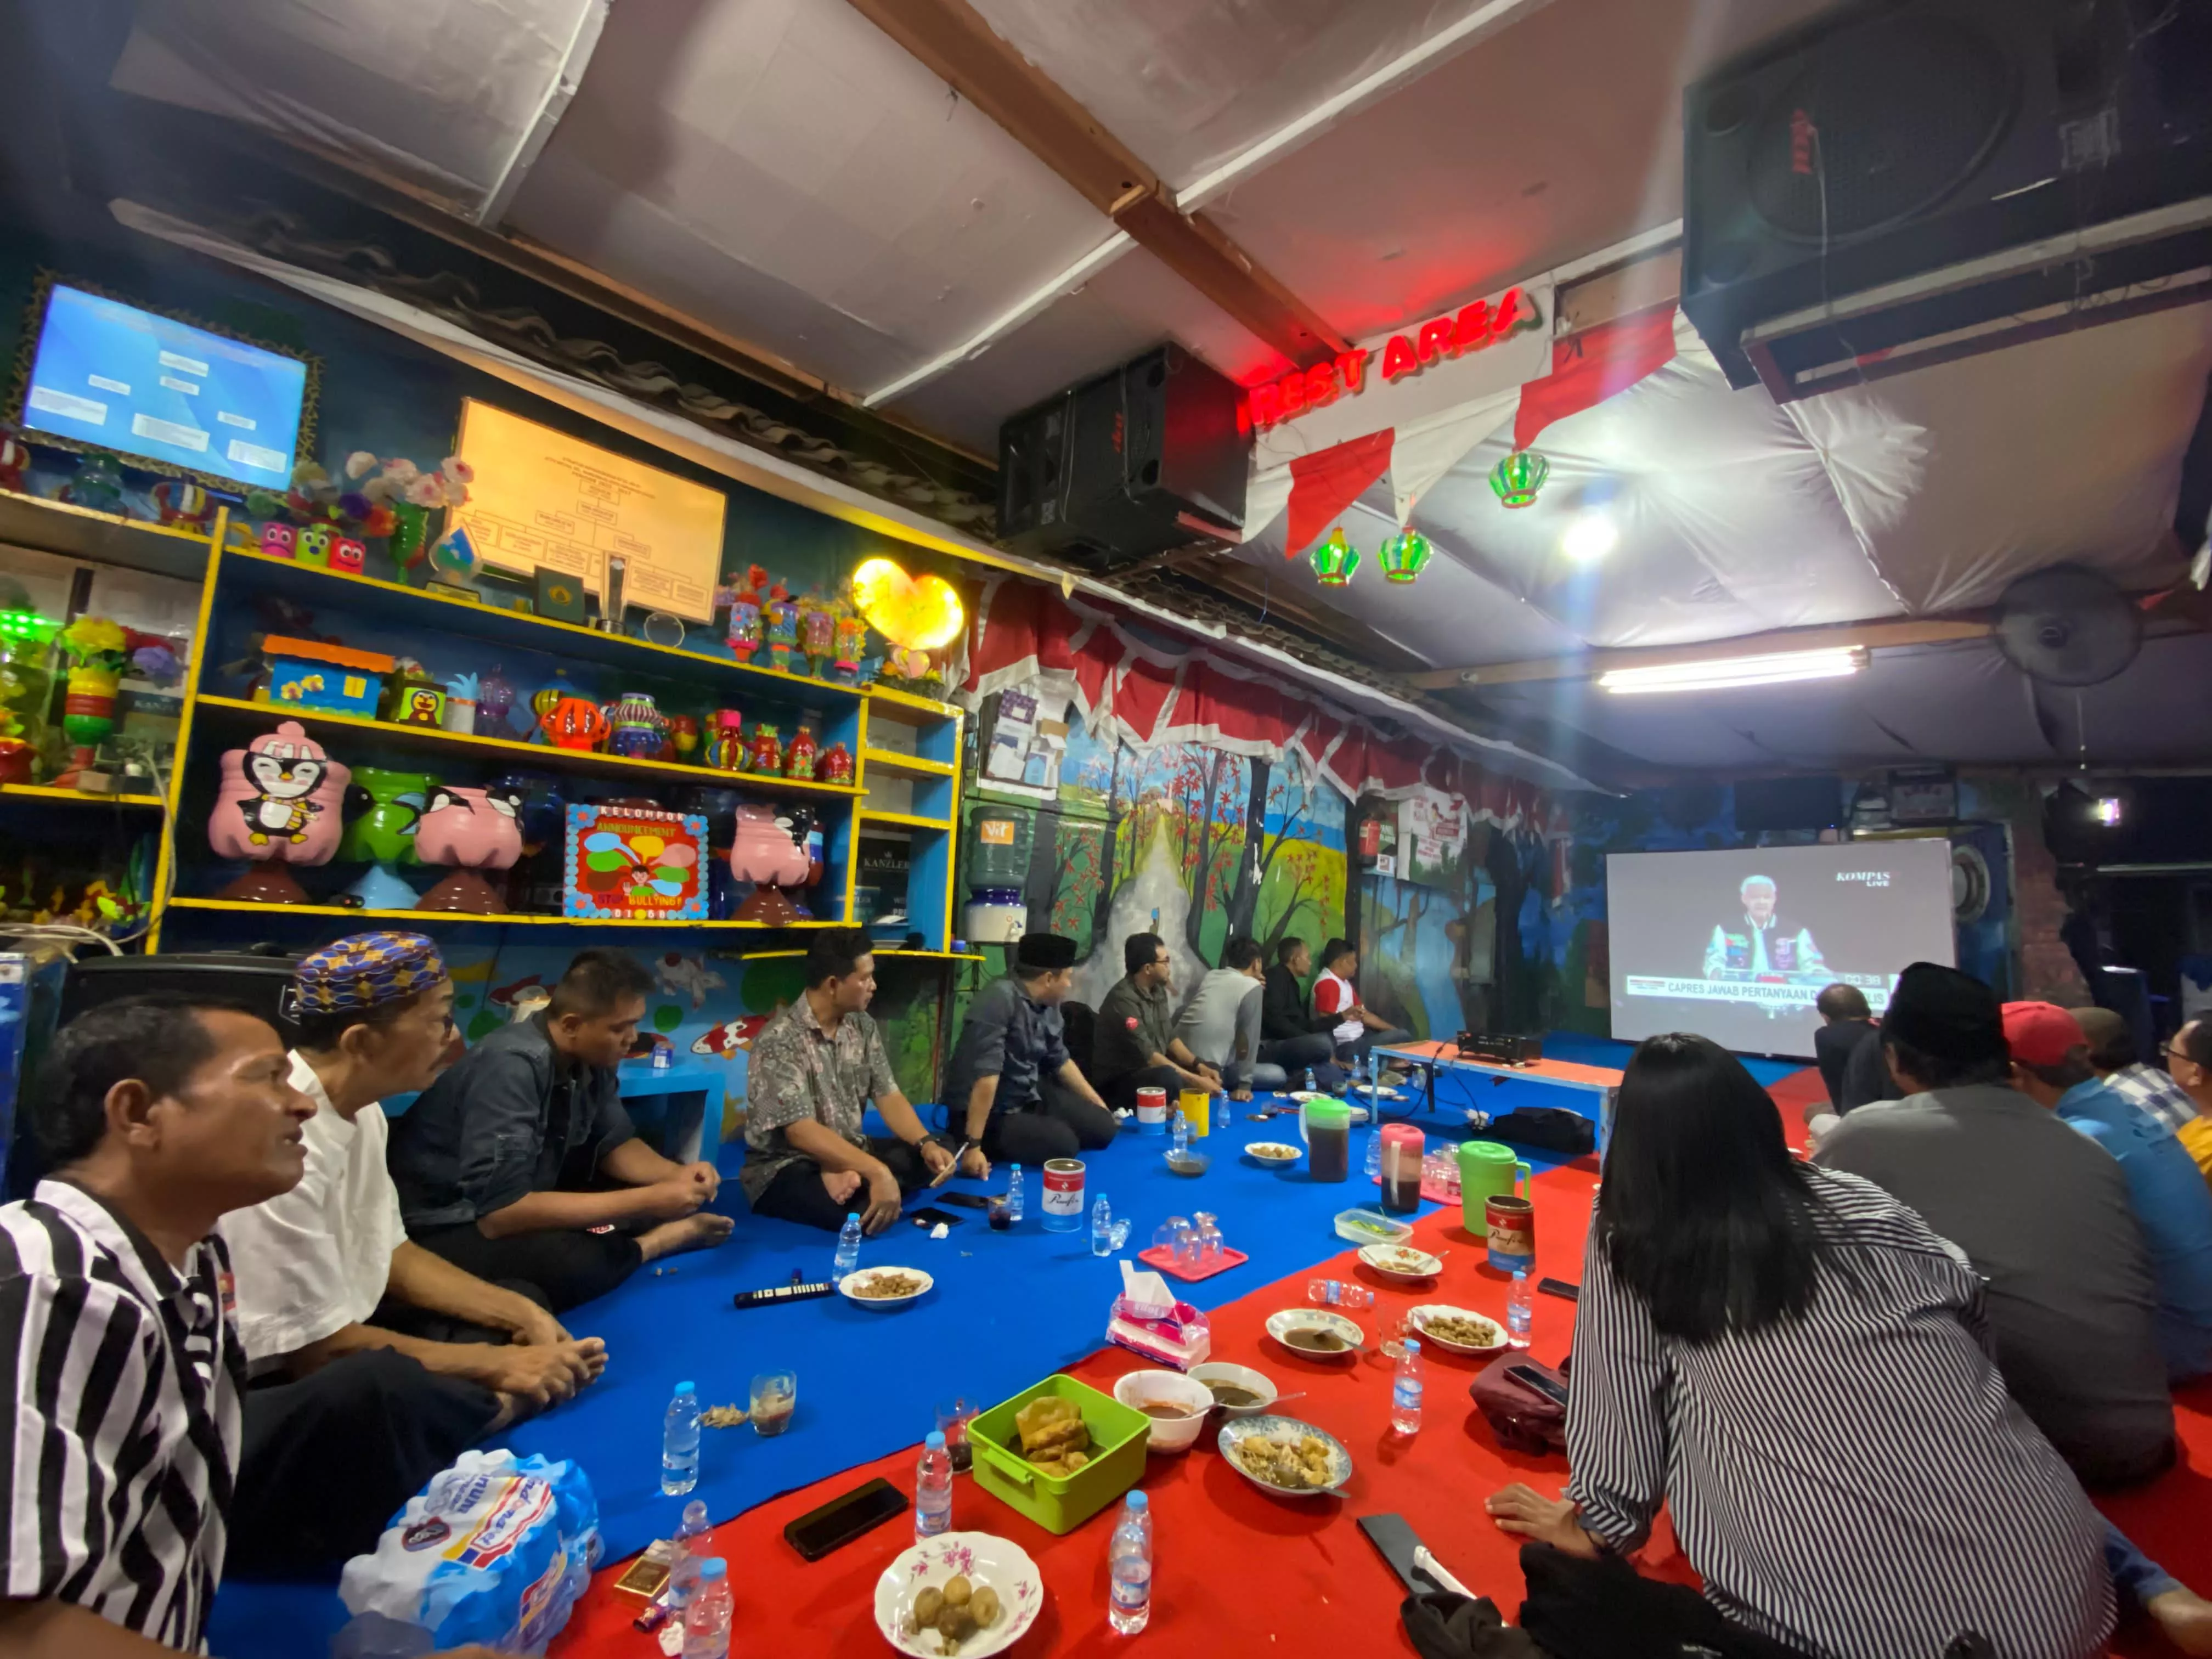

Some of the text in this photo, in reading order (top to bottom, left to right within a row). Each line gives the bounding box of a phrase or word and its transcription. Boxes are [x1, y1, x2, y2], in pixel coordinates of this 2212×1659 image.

[1250, 287, 1543, 427] REST AREA
[601, 805, 685, 821] KELOMPOK
[596, 822, 676, 837] ANNOUNCEMENT
[984, 821, 1010, 839] Vit
[1836, 871, 1891, 881] KOMPAS
[628, 895, 682, 906] BULLYING!
[1668, 982, 1705, 995] CAPRES
[1707, 985, 1740, 997] JAWAB
[1741, 986, 1809, 1000] PERTANYAAN
[1866, 992, 1884, 1005] LIS
